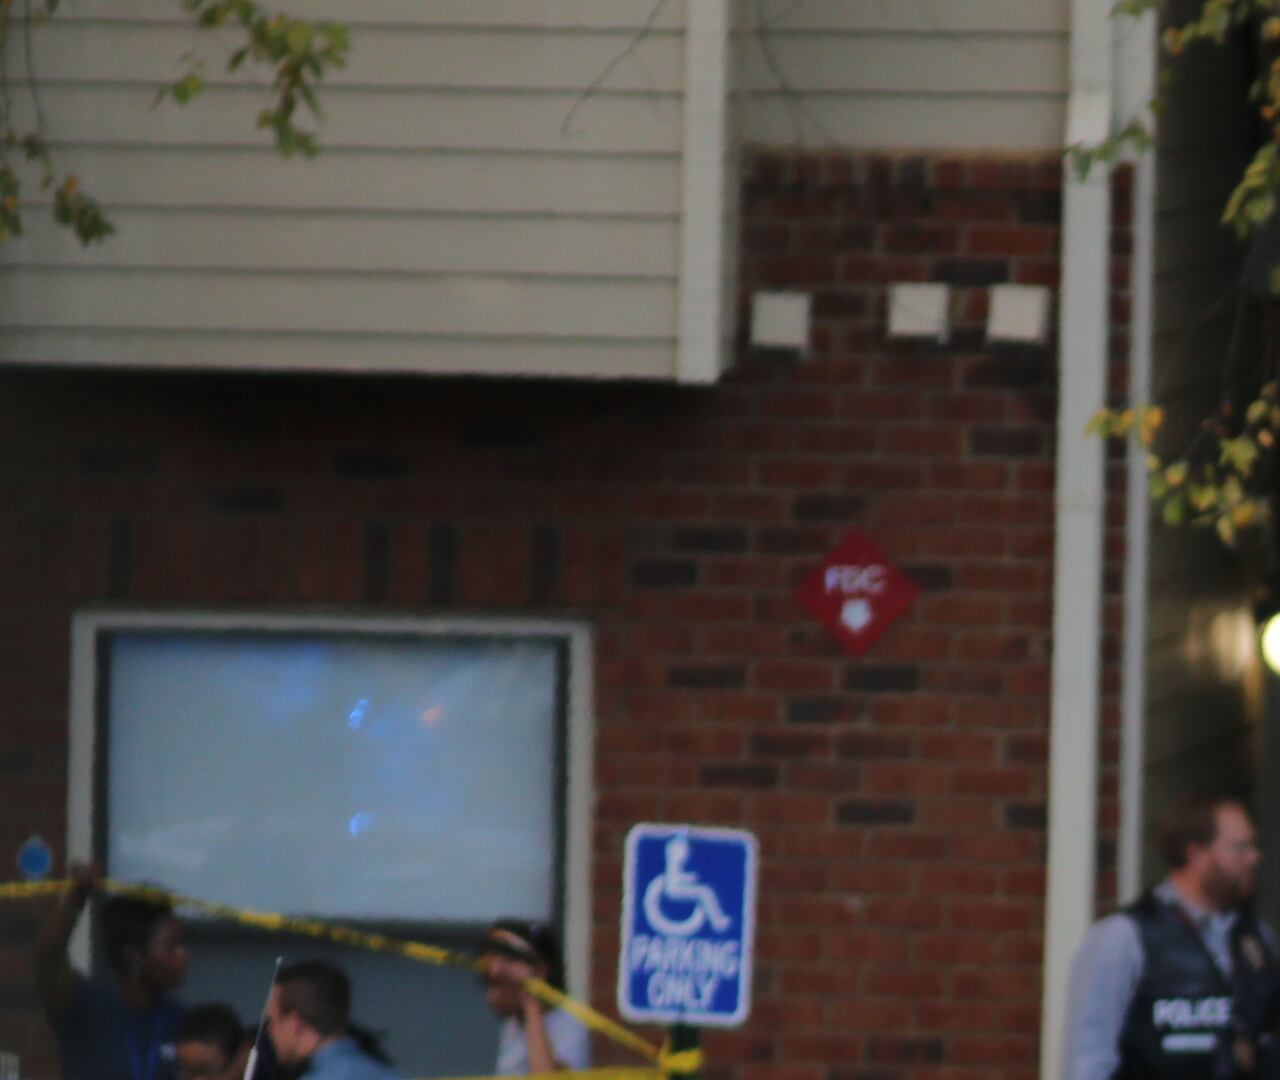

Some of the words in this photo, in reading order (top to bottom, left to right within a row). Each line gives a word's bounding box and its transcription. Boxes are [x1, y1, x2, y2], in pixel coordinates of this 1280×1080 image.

[630, 933, 740, 979] PARKING
[647, 970, 717, 1010] ONLY
[1153, 997, 1231, 1028] POLICE
